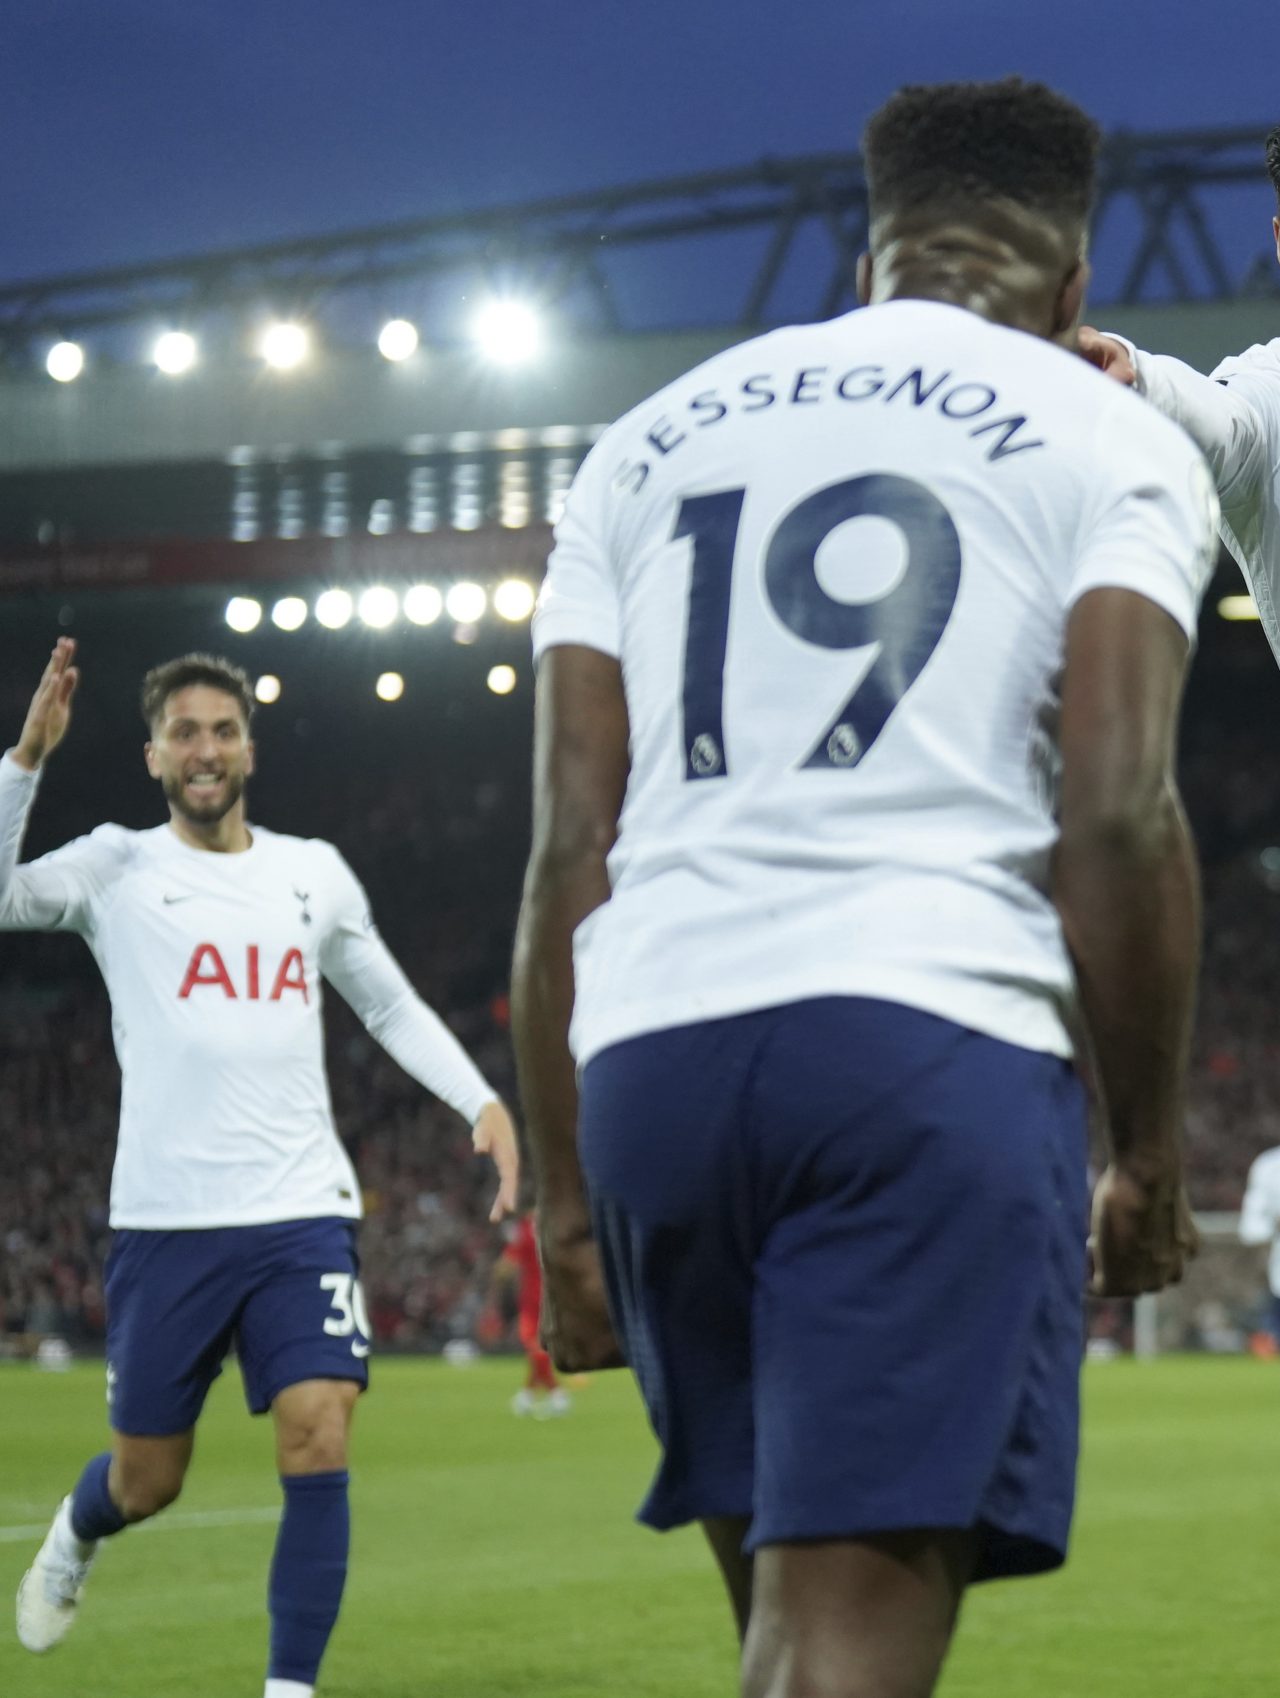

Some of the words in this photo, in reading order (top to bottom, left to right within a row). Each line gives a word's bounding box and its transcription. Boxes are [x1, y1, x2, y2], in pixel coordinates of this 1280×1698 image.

[612, 365, 1044, 496] SESSEGNON
[671, 471, 962, 782] 19
[178, 942, 309, 1005] AIA
